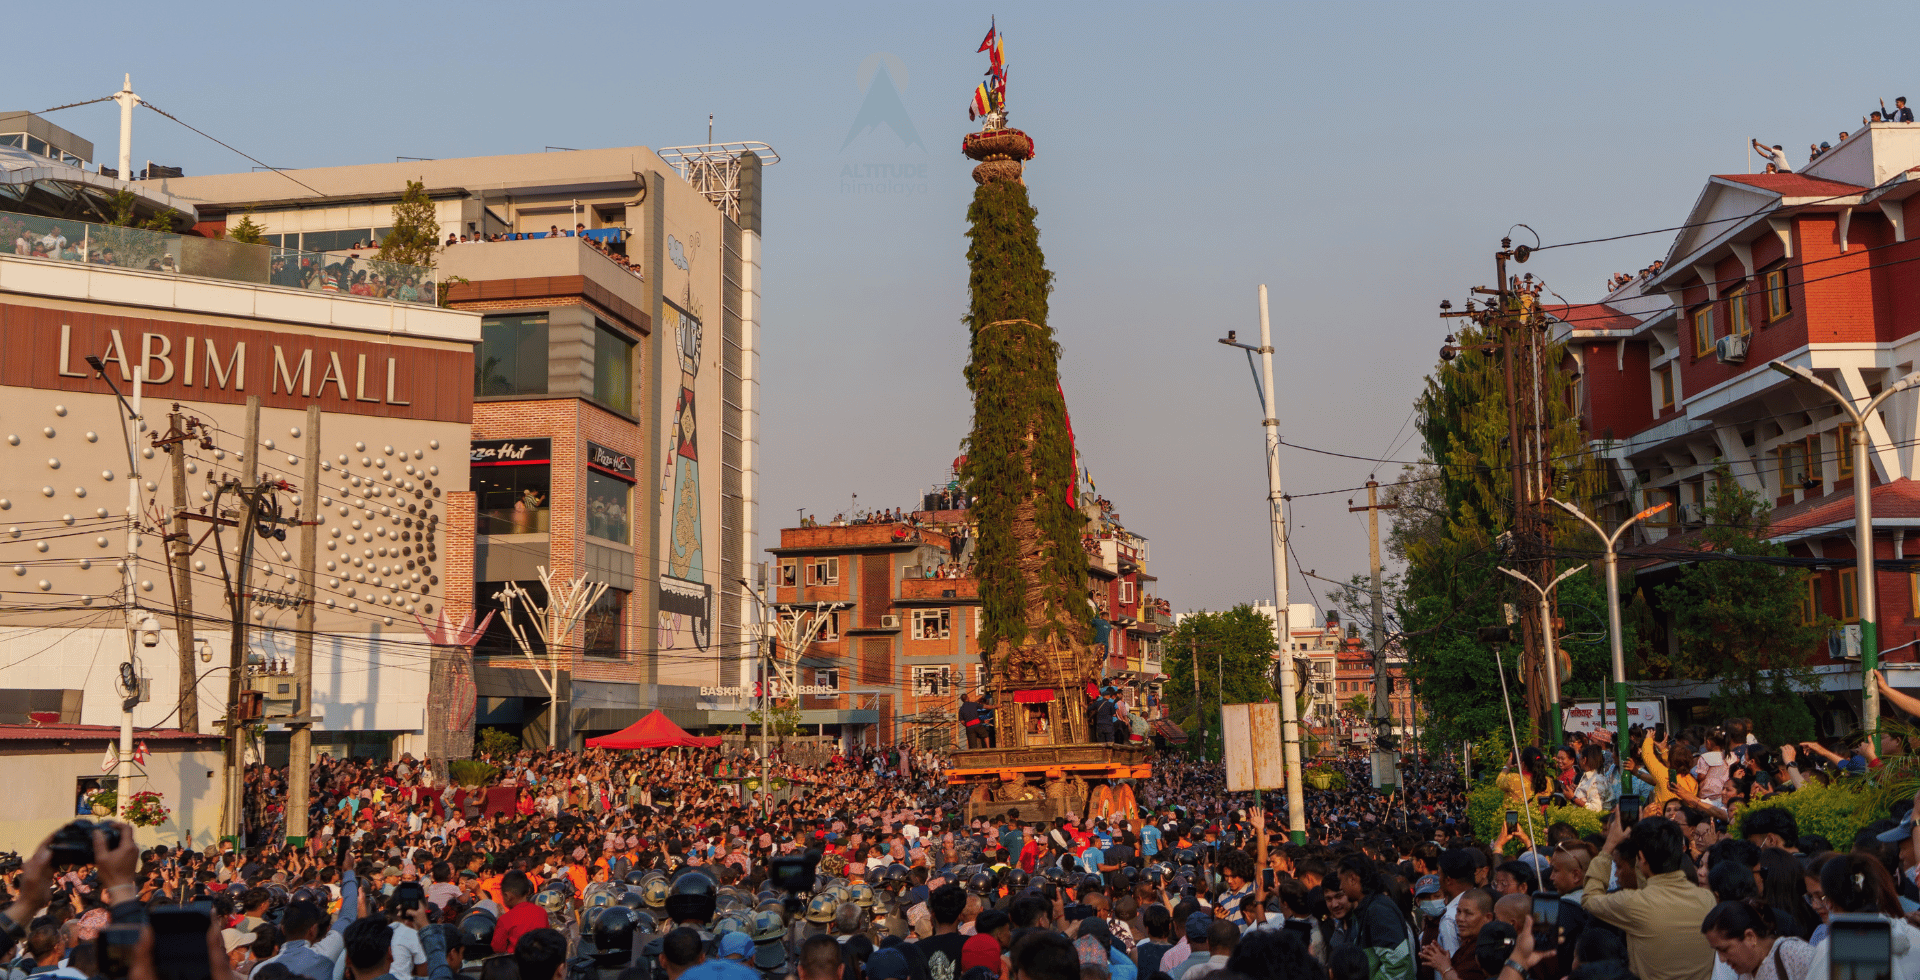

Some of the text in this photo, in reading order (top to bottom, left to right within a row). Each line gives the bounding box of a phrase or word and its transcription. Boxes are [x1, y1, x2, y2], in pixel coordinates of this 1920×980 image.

[58, 324, 411, 405] LABIM MALL
[497, 443, 533, 460] Hut
[595, 447, 613, 466] Pizza
[700, 686, 743, 696] BASKIN
[780, 685, 834, 695] OBBINS
